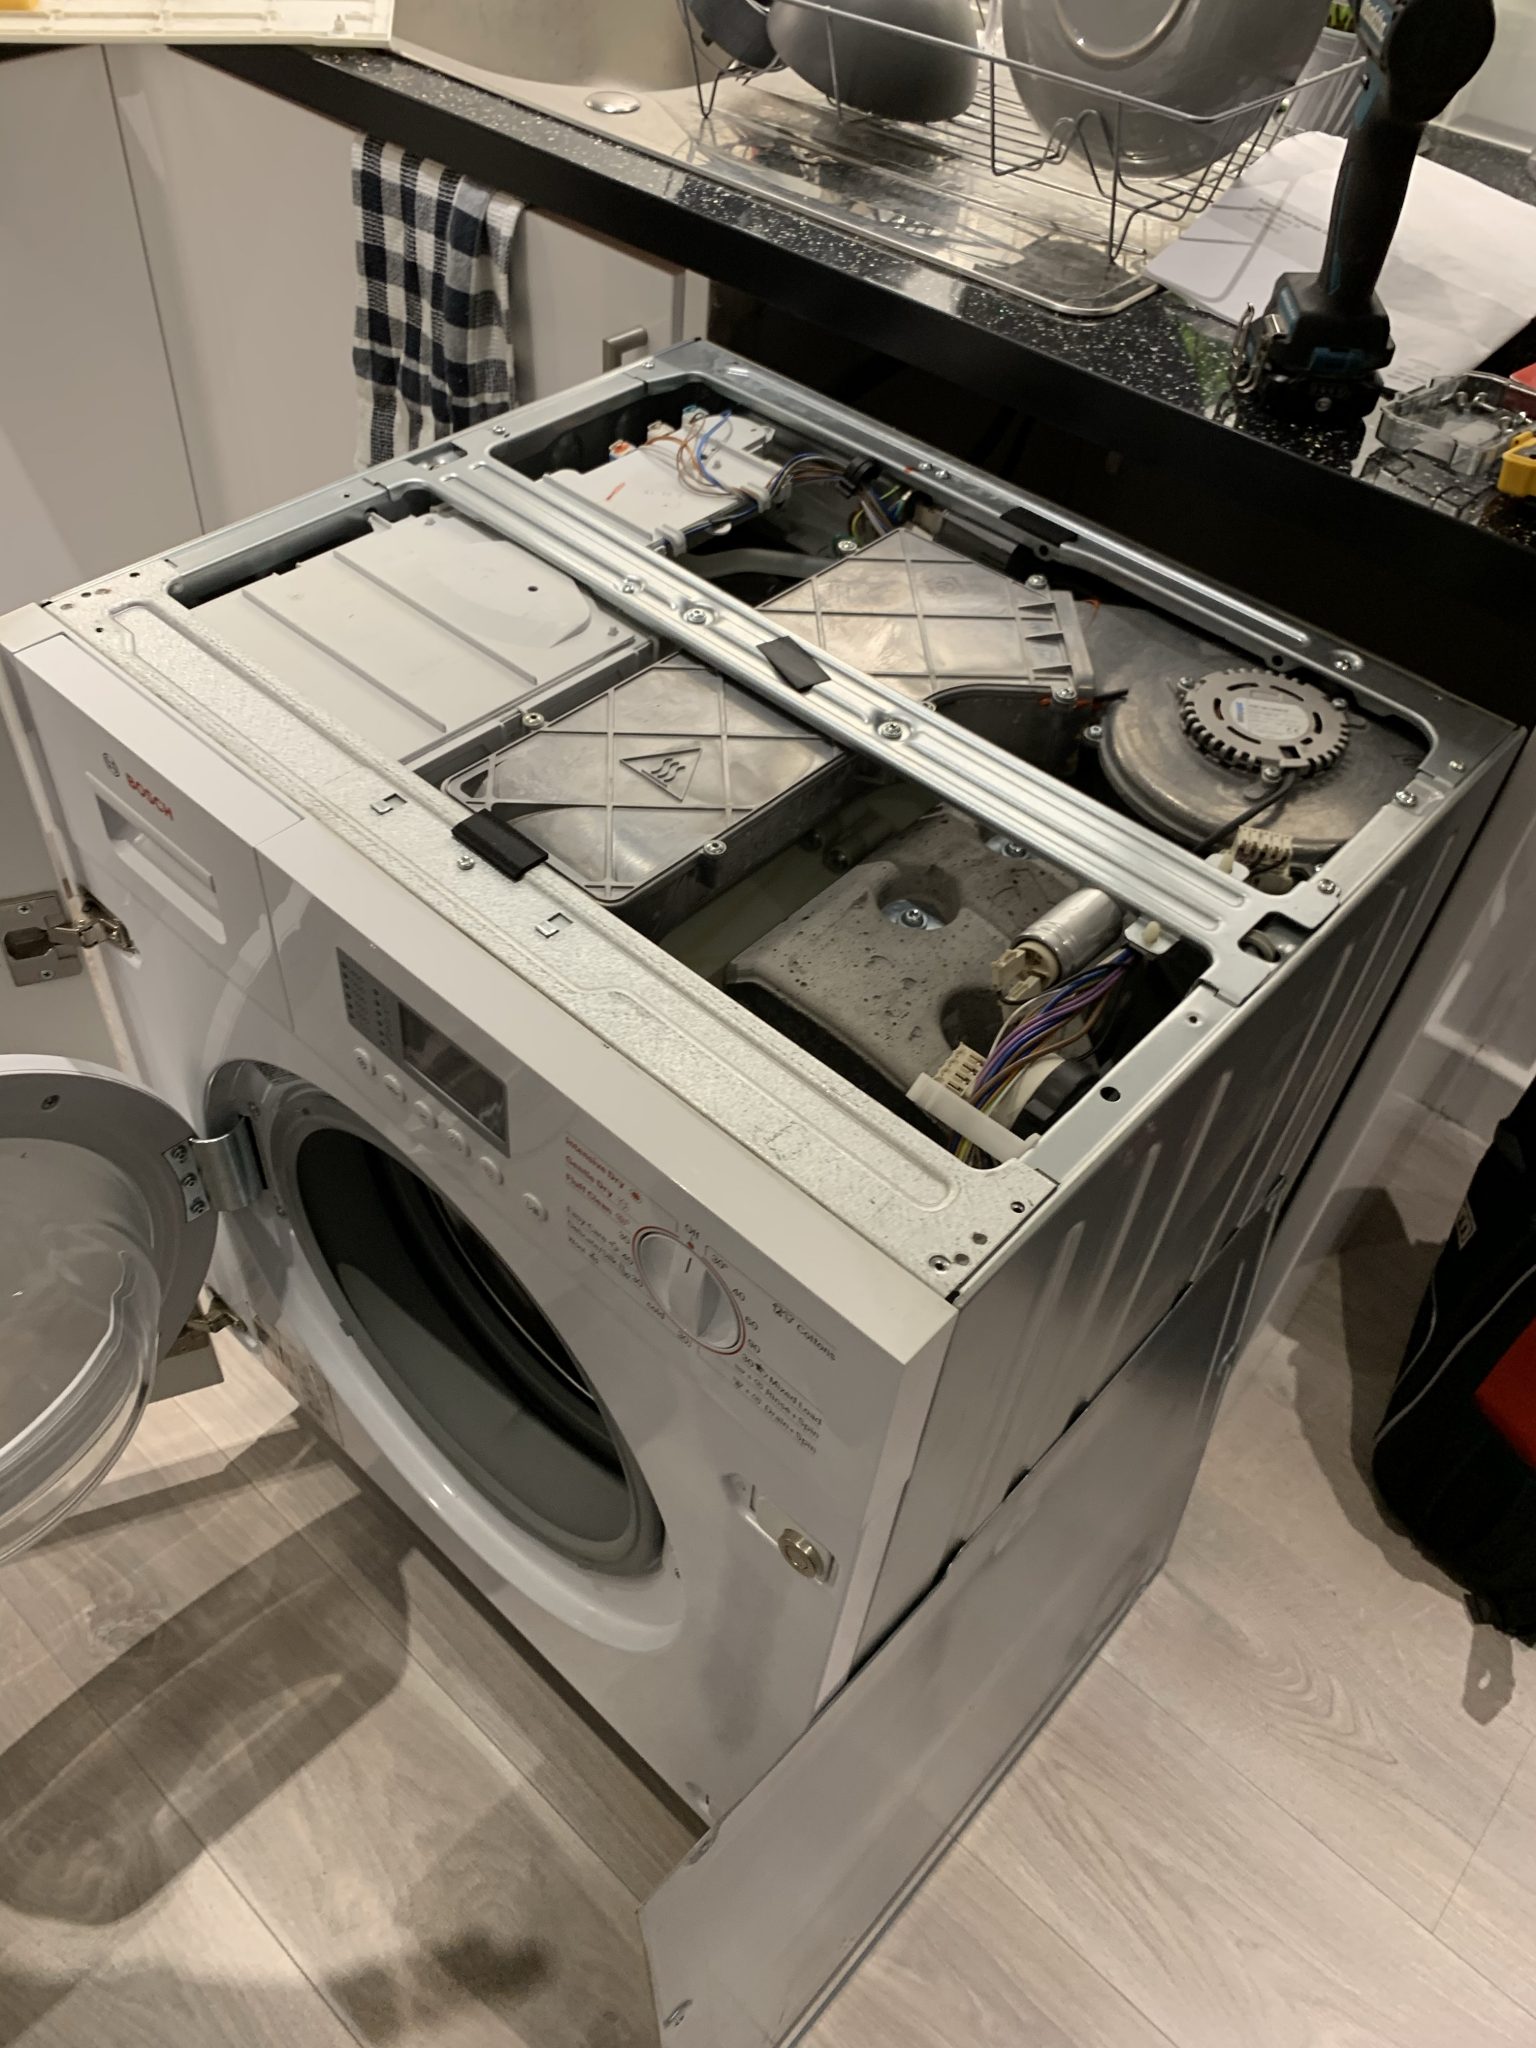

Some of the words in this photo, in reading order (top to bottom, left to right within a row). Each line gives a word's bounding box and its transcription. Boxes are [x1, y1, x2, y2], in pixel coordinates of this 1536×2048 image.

[125, 773, 174, 821] BOSCH
[797, 1324, 836, 1361] Cottons
[799, 1402, 822, 1426] Load
[798, 1416, 820, 1440] Spin
[796, 1431, 818, 1455] Spin
